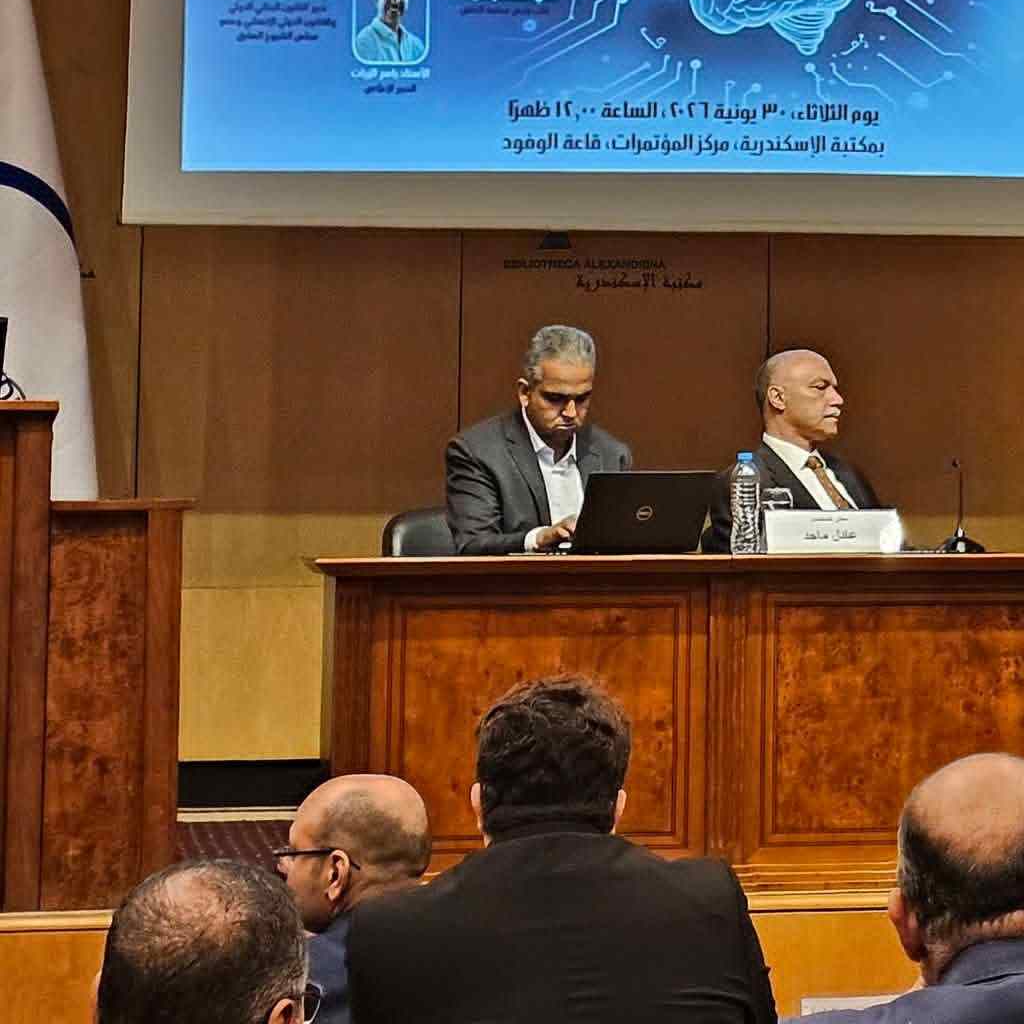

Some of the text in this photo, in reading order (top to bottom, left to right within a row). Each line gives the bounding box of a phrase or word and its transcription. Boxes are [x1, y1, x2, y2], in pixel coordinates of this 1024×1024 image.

[601, 101, 657, 119] الساعة
[762, 103, 785, 120] ٣٠
[851, 108, 879, 126] يوم
[503, 132, 558, 154] الوفود
[563, 132, 600, 150] قاعة
[696, 134, 729, 156] مركز
[831, 135, 885, 158] بمكتبة
